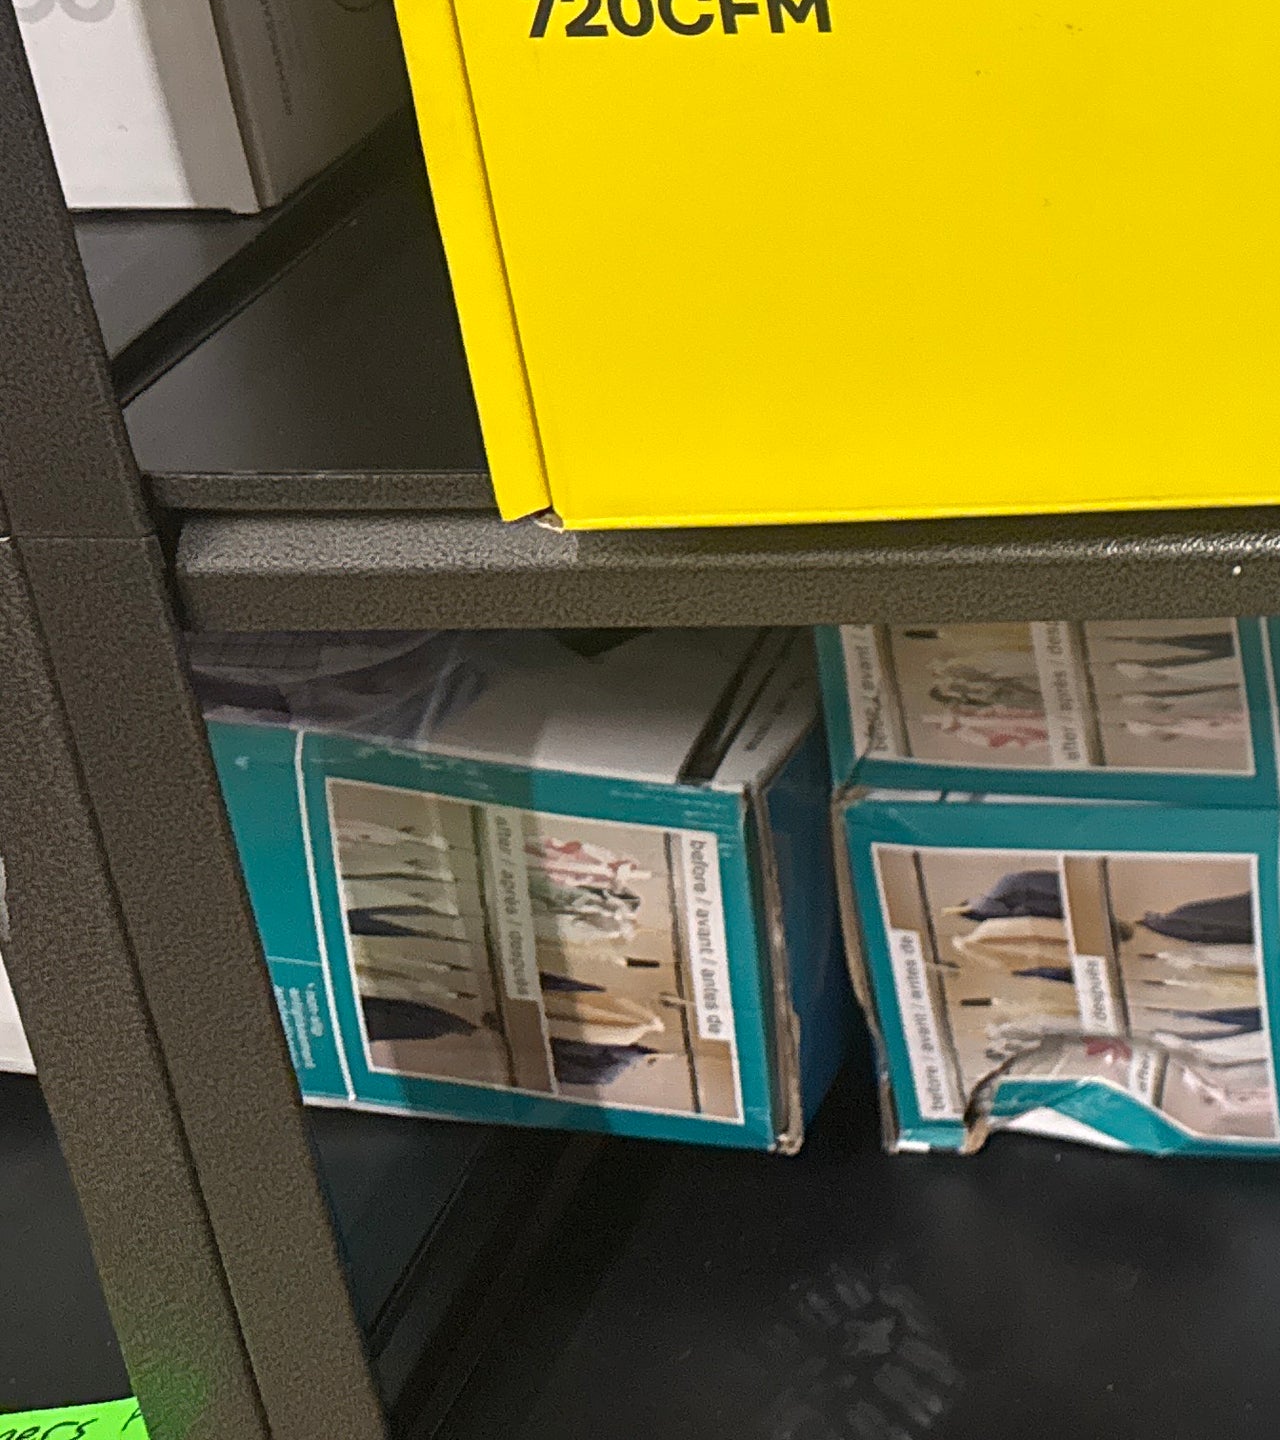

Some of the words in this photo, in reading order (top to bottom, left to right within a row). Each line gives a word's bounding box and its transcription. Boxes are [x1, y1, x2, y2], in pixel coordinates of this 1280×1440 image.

[690, 839, 708, 894] before
[696, 908, 714, 955] avant
[700, 967, 717, 1012] antes
[914, 1012, 935, 1053] avant
[925, 1064, 947, 1111] before
